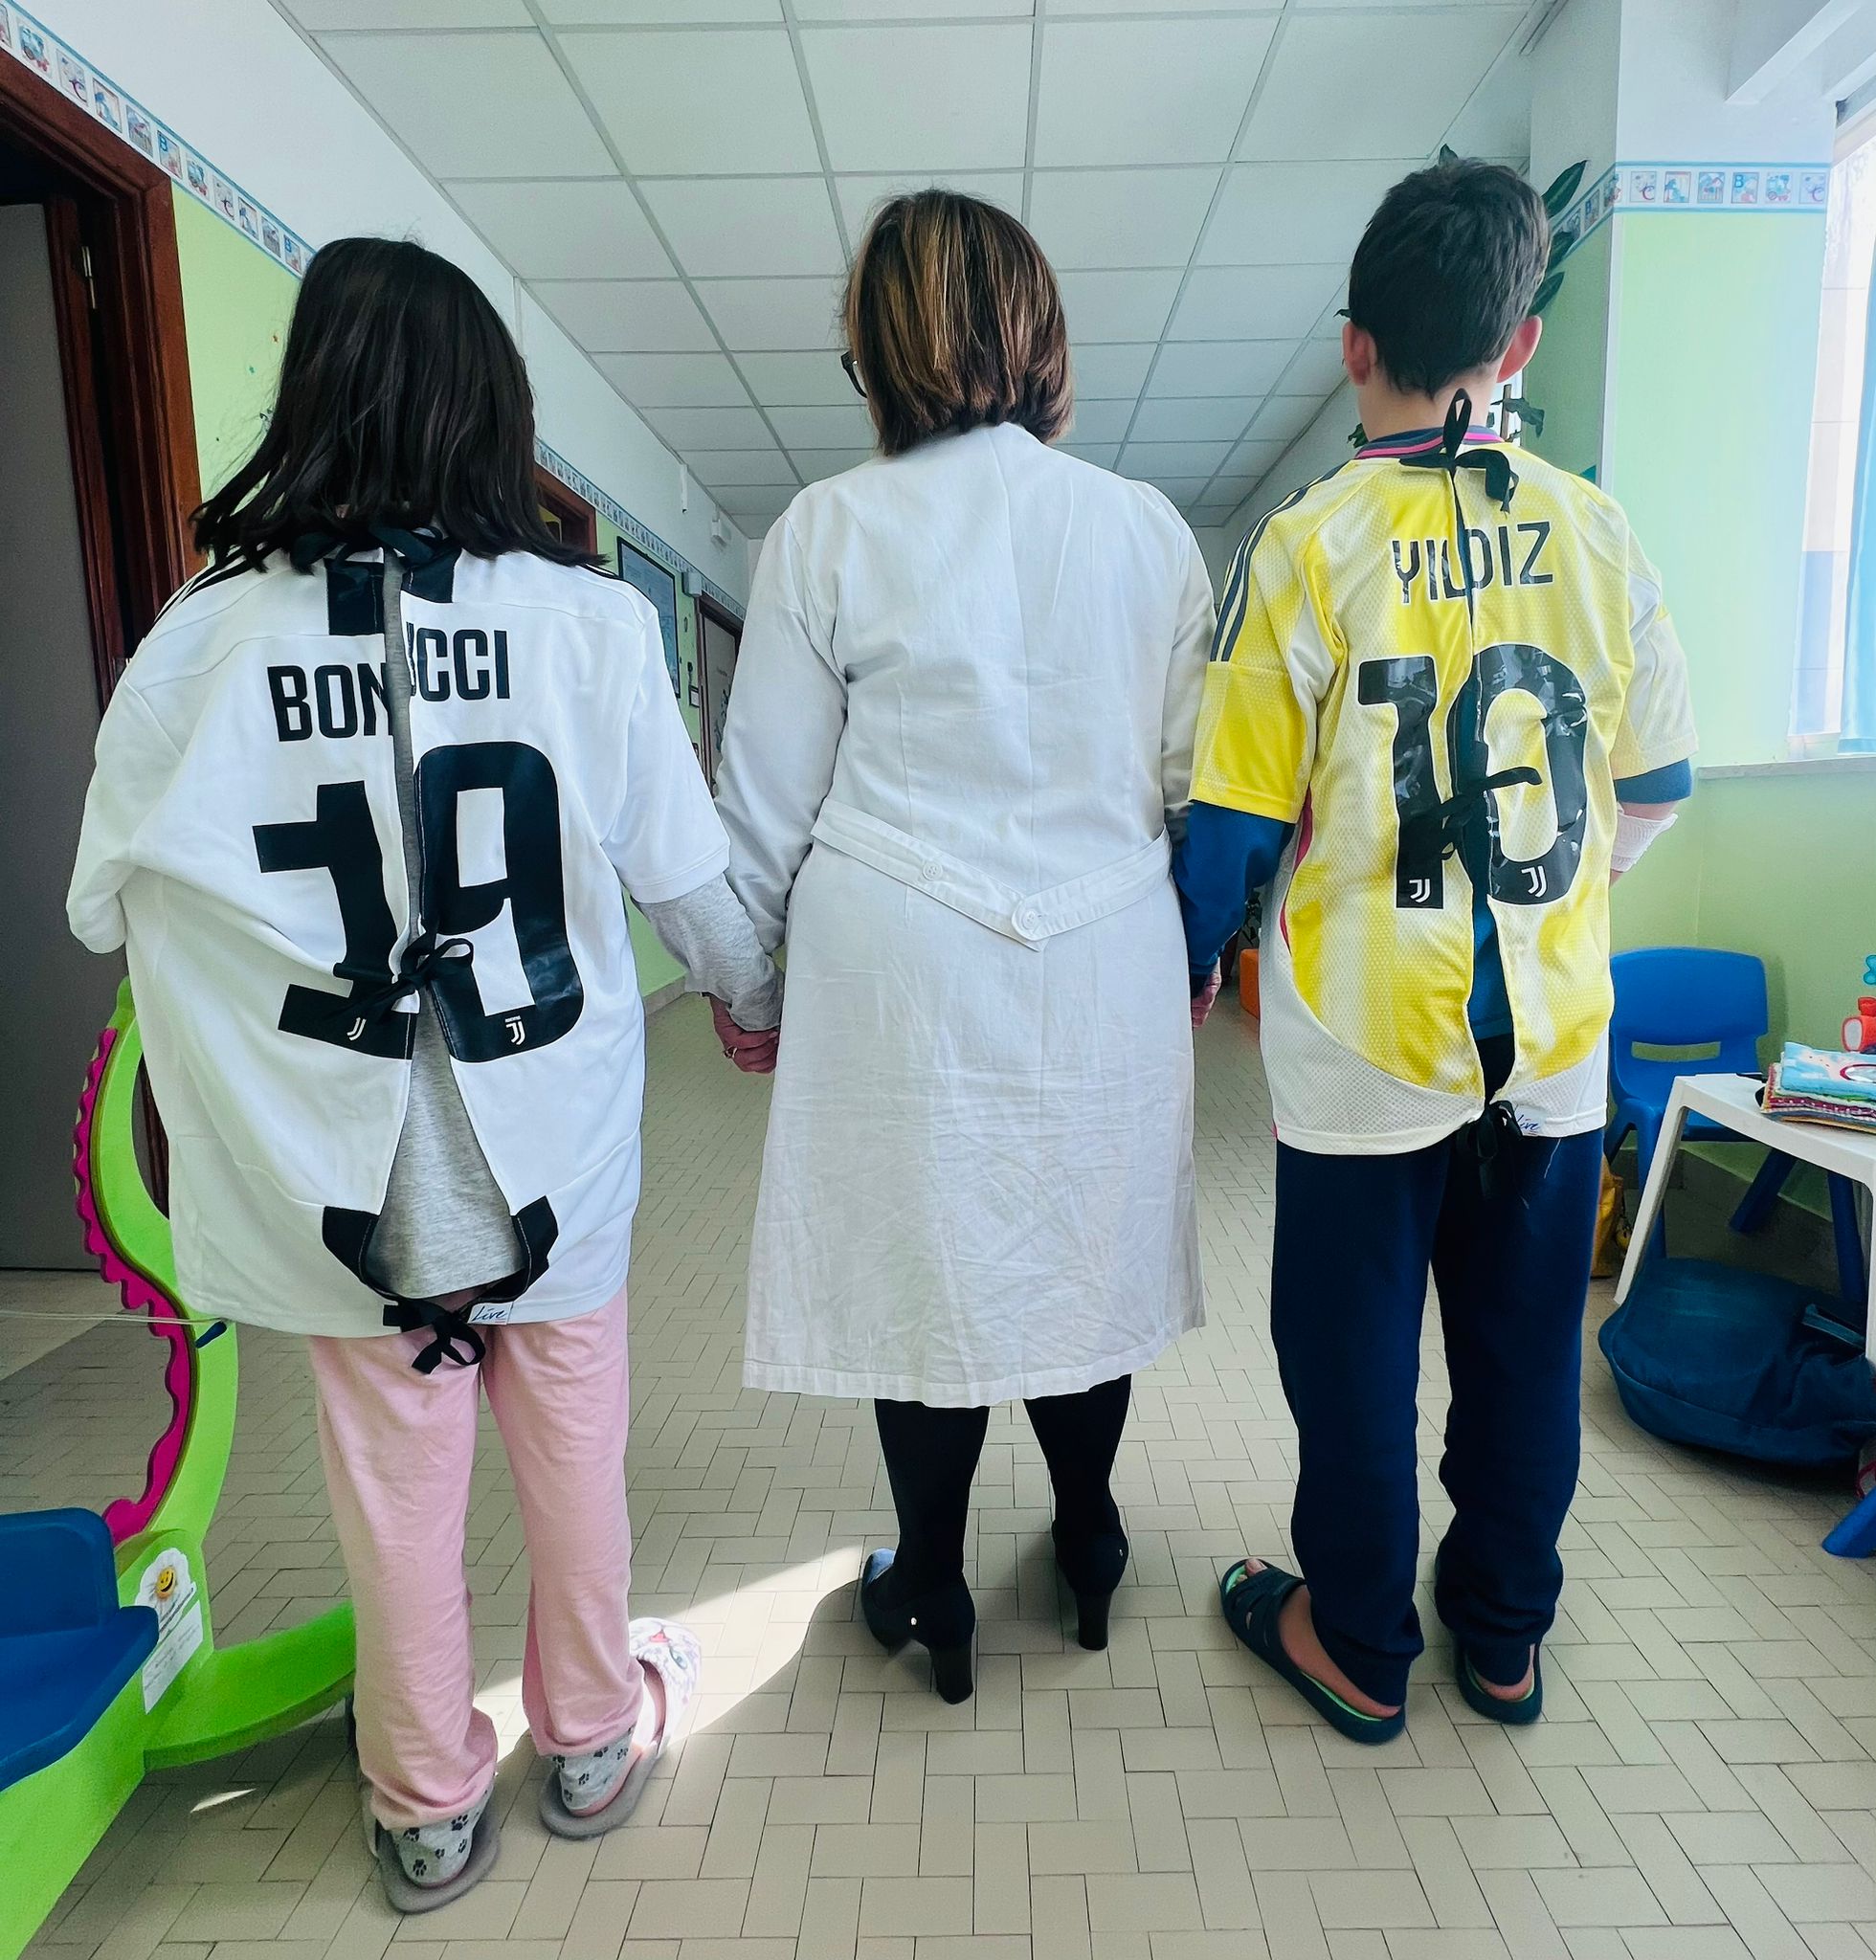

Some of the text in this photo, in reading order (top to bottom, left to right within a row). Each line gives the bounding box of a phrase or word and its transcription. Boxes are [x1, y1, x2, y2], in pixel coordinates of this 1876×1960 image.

[159, 135, 168, 152] B
[1733, 174, 1745, 189] B
[1392, 522, 1553, 604] YILDIZ
[267, 621, 511, 743] BONCCI
[1358, 643, 1589, 909] 10
[252, 741, 585, 1063] 19
[471, 1305, 508, 1321] Live
